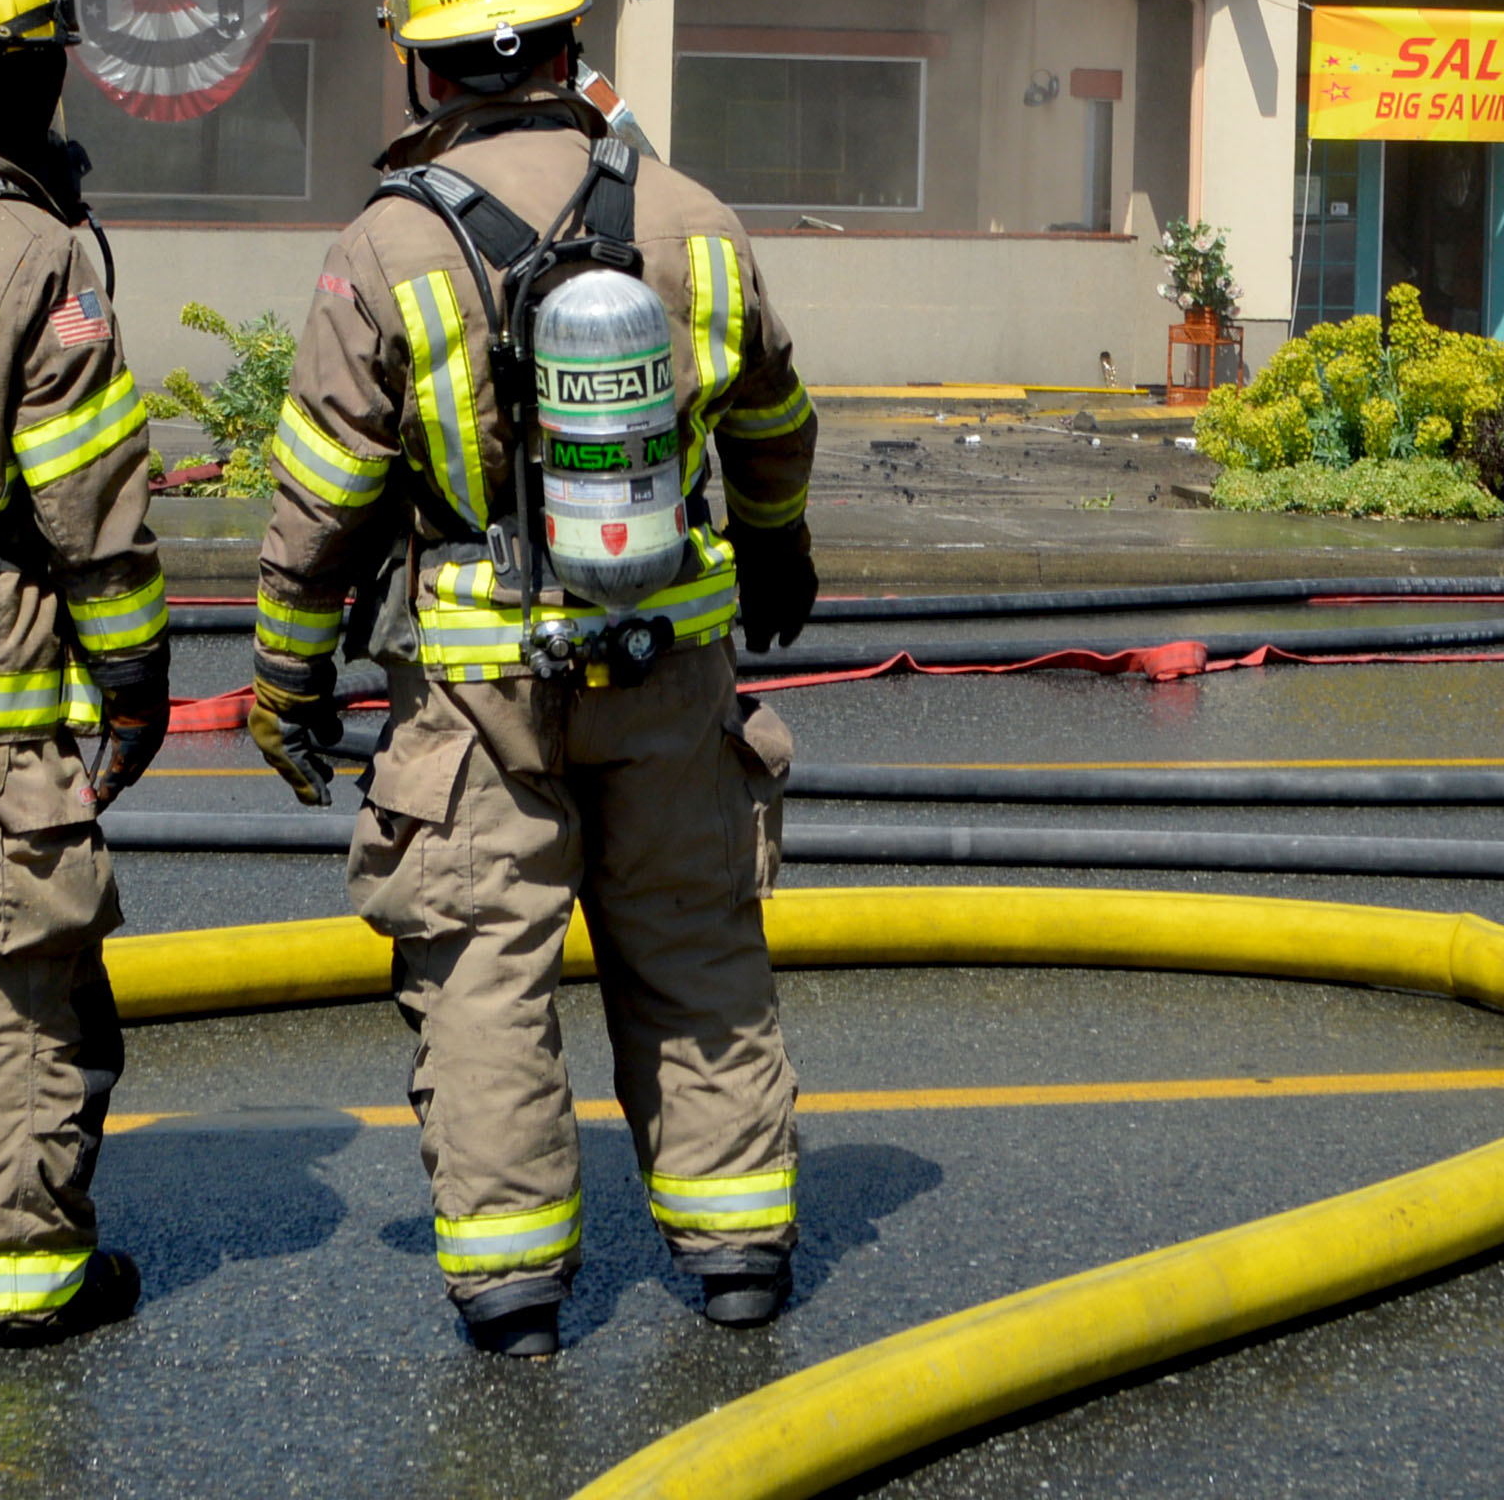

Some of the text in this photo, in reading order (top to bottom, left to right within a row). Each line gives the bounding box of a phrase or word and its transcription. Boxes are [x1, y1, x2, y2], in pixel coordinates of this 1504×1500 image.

[1375, 92, 1422, 120] BIG
[562, 371, 644, 401] MSA
[555, 442, 630, 469] MSA
